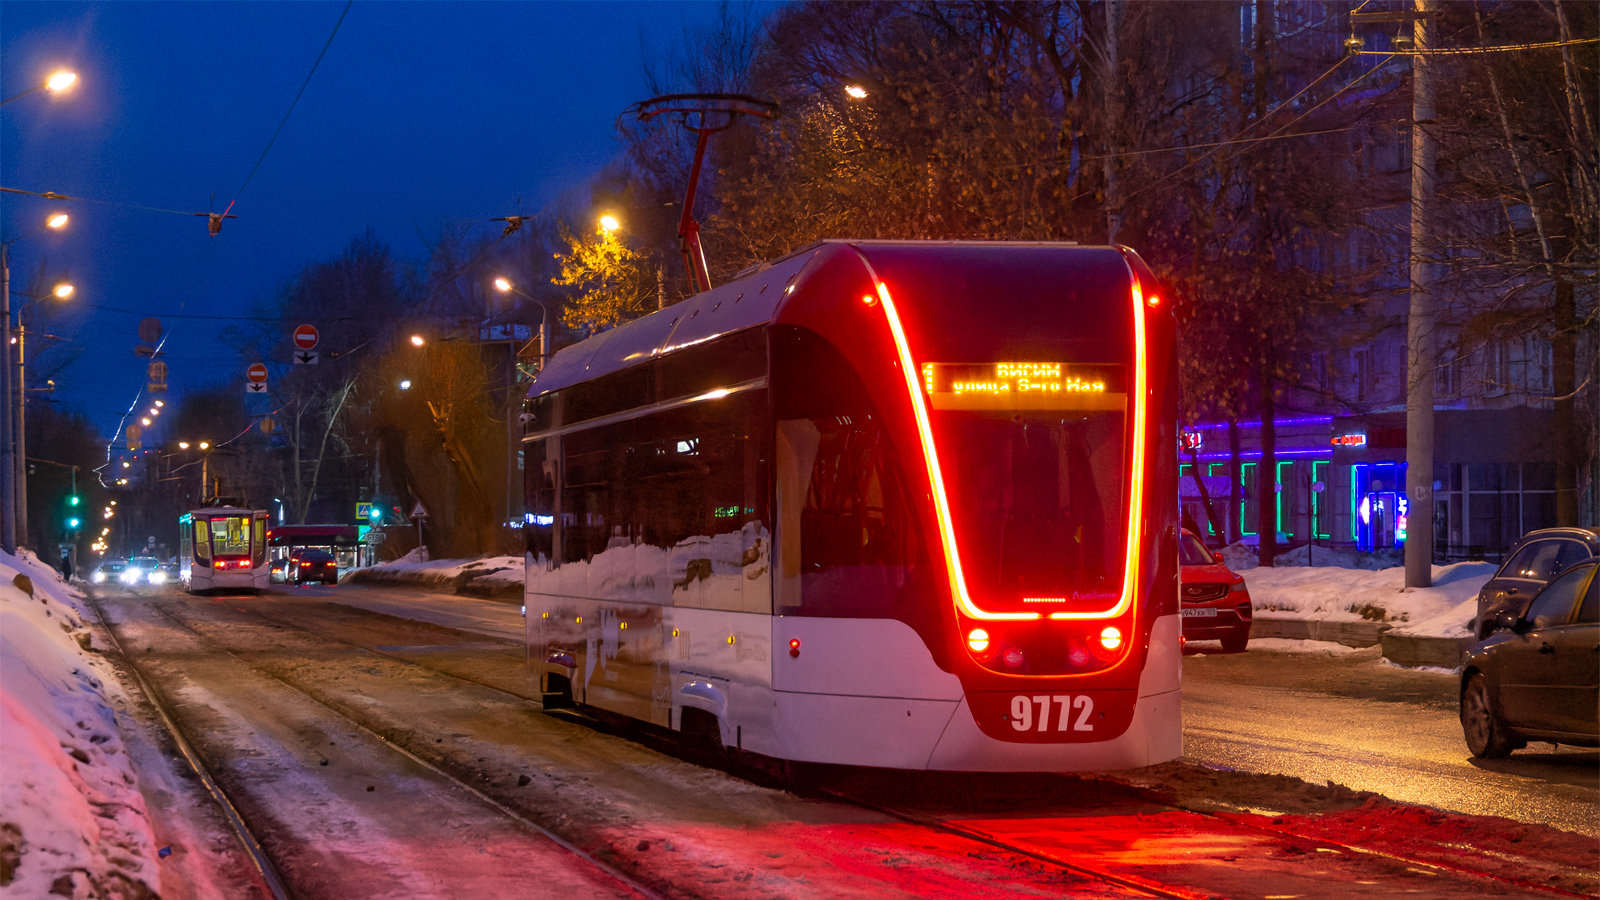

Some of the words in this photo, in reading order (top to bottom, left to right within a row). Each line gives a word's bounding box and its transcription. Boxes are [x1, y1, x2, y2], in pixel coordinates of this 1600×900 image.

[922, 364, 933, 394] 1
[997, 363, 1060, 377] ВИСИМ
[953, 381, 1010, 394] улица
[1066, 378, 1104, 392] Мая
[1010, 695, 1094, 732] 9772
